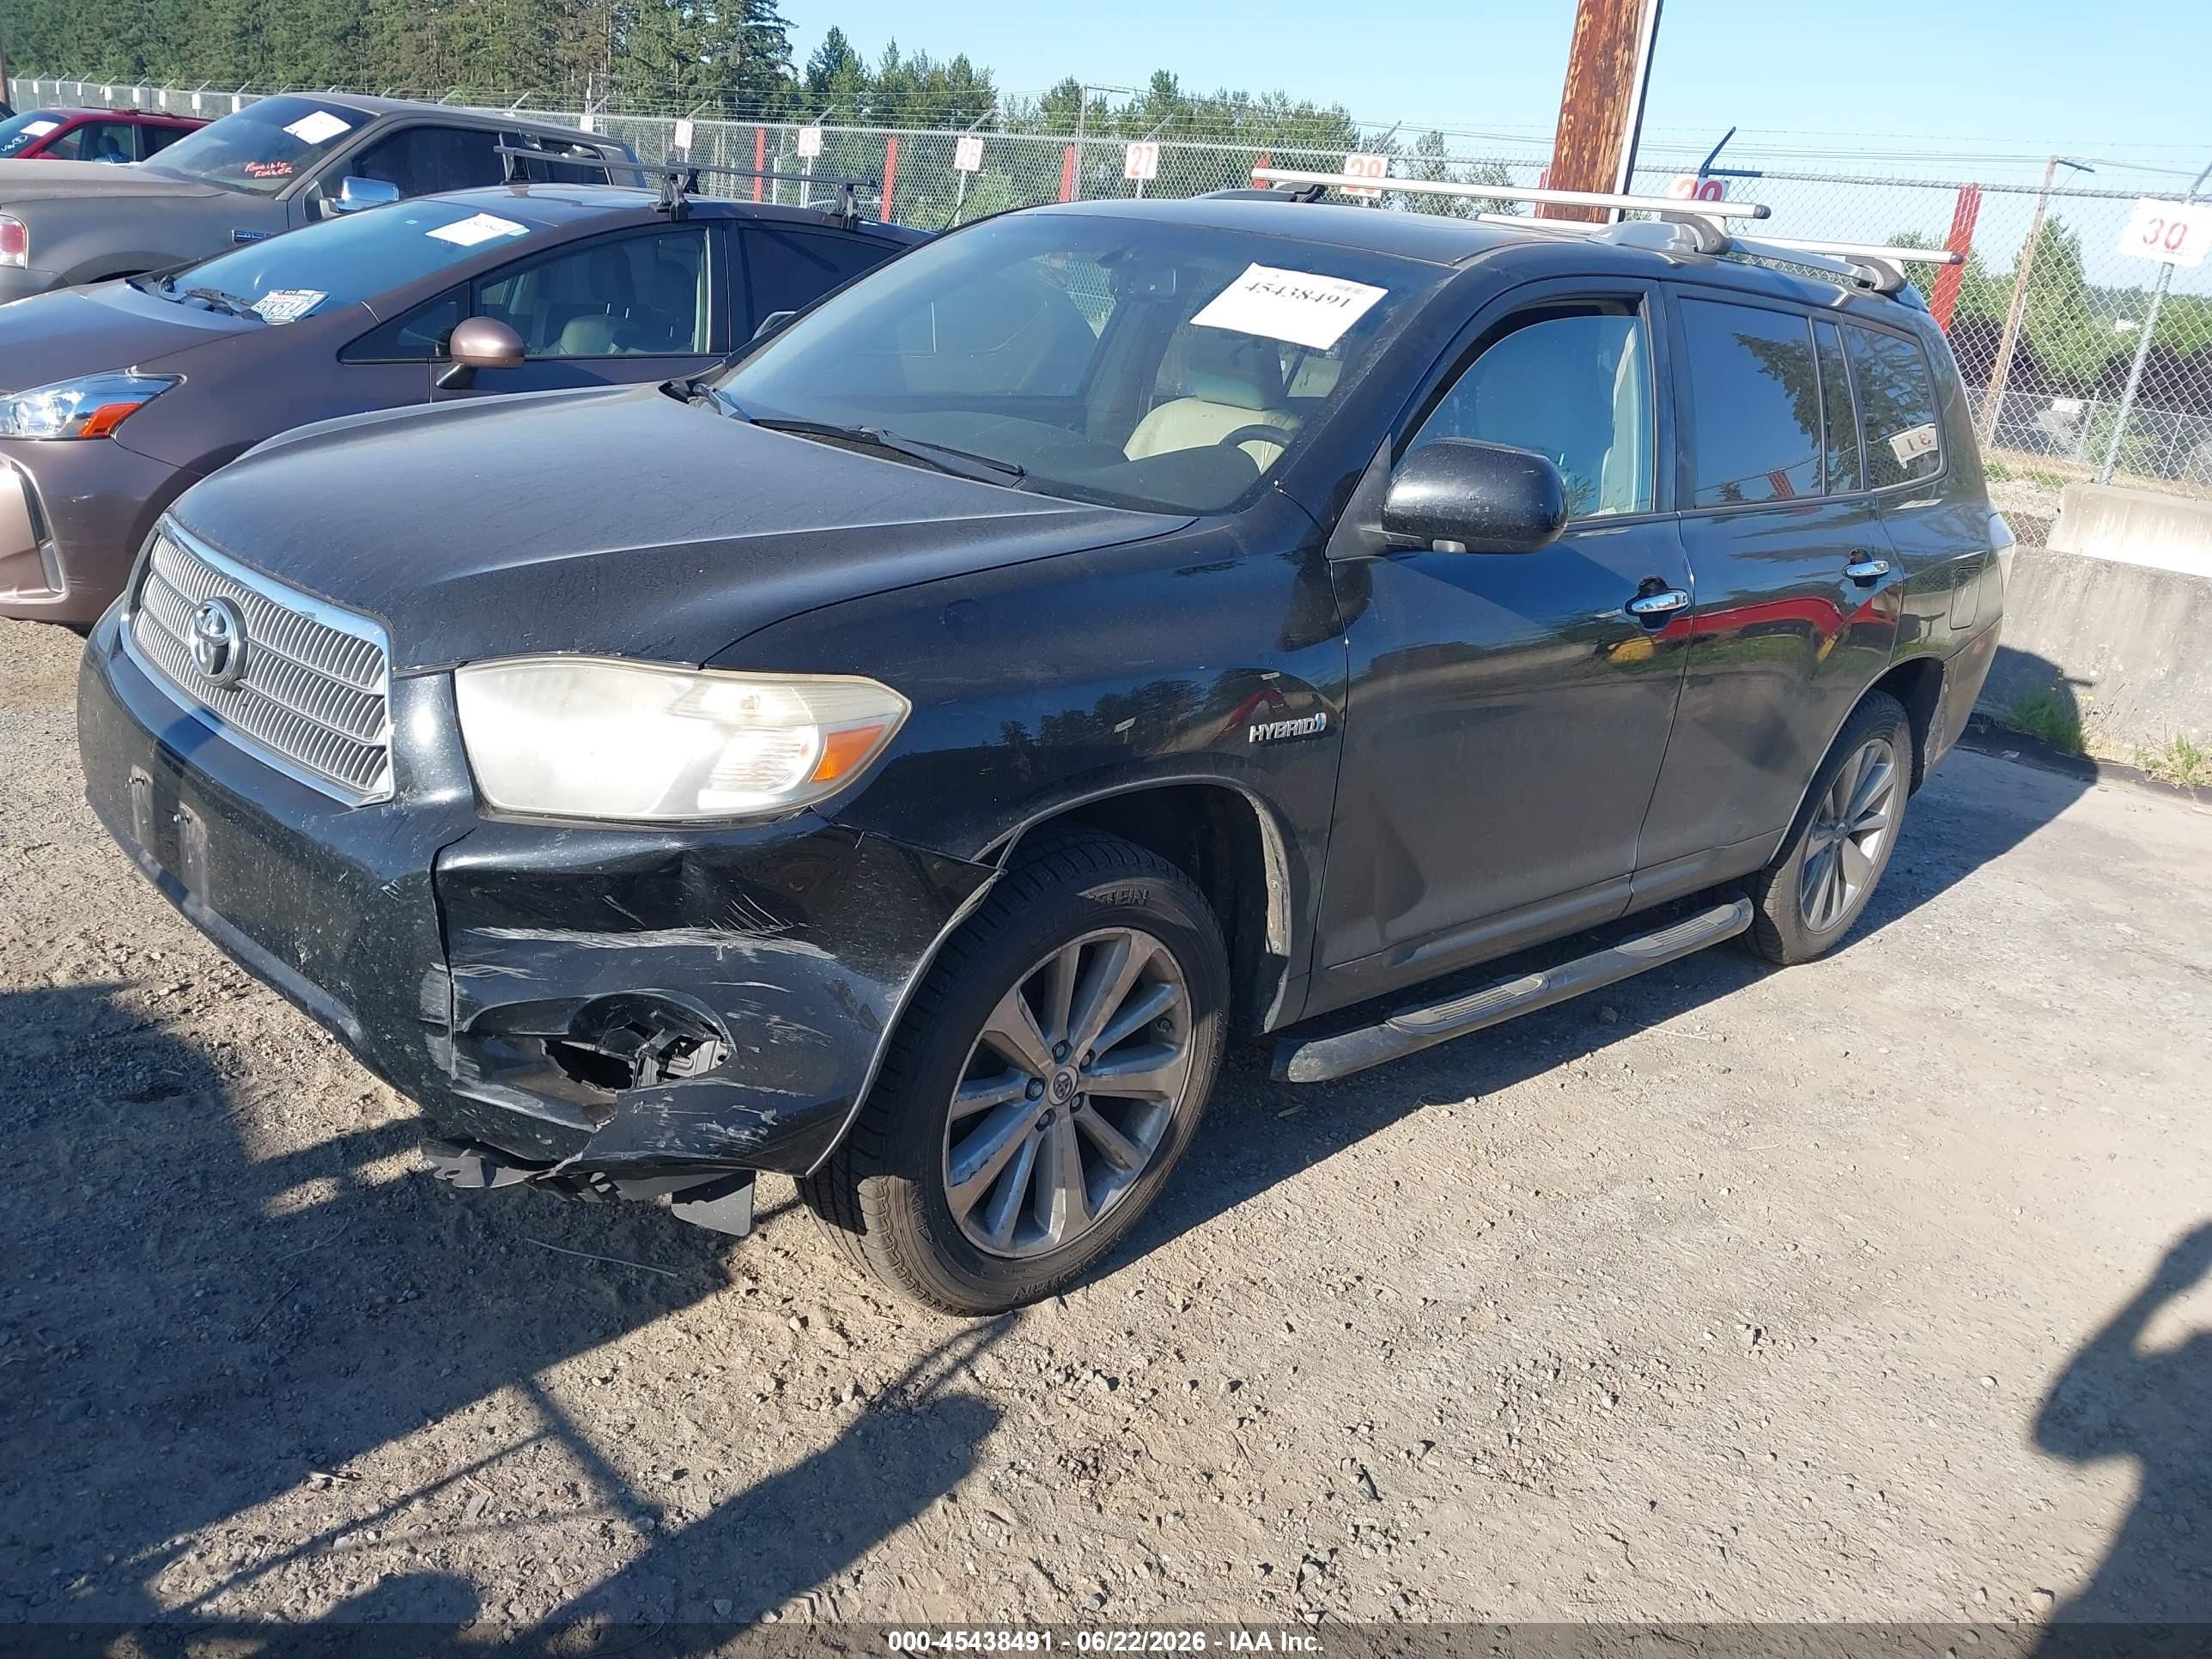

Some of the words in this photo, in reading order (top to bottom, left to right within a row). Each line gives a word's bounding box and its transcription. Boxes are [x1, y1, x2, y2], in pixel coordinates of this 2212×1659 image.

[801, 130, 817, 154] 25
[958, 141, 978, 168] 26
[1130, 145, 1154, 177] 27
[2142, 218, 2188, 250] 30
[1244, 282, 1351, 307] 45438491
[1249, 717, 1315, 743] HYBRID
